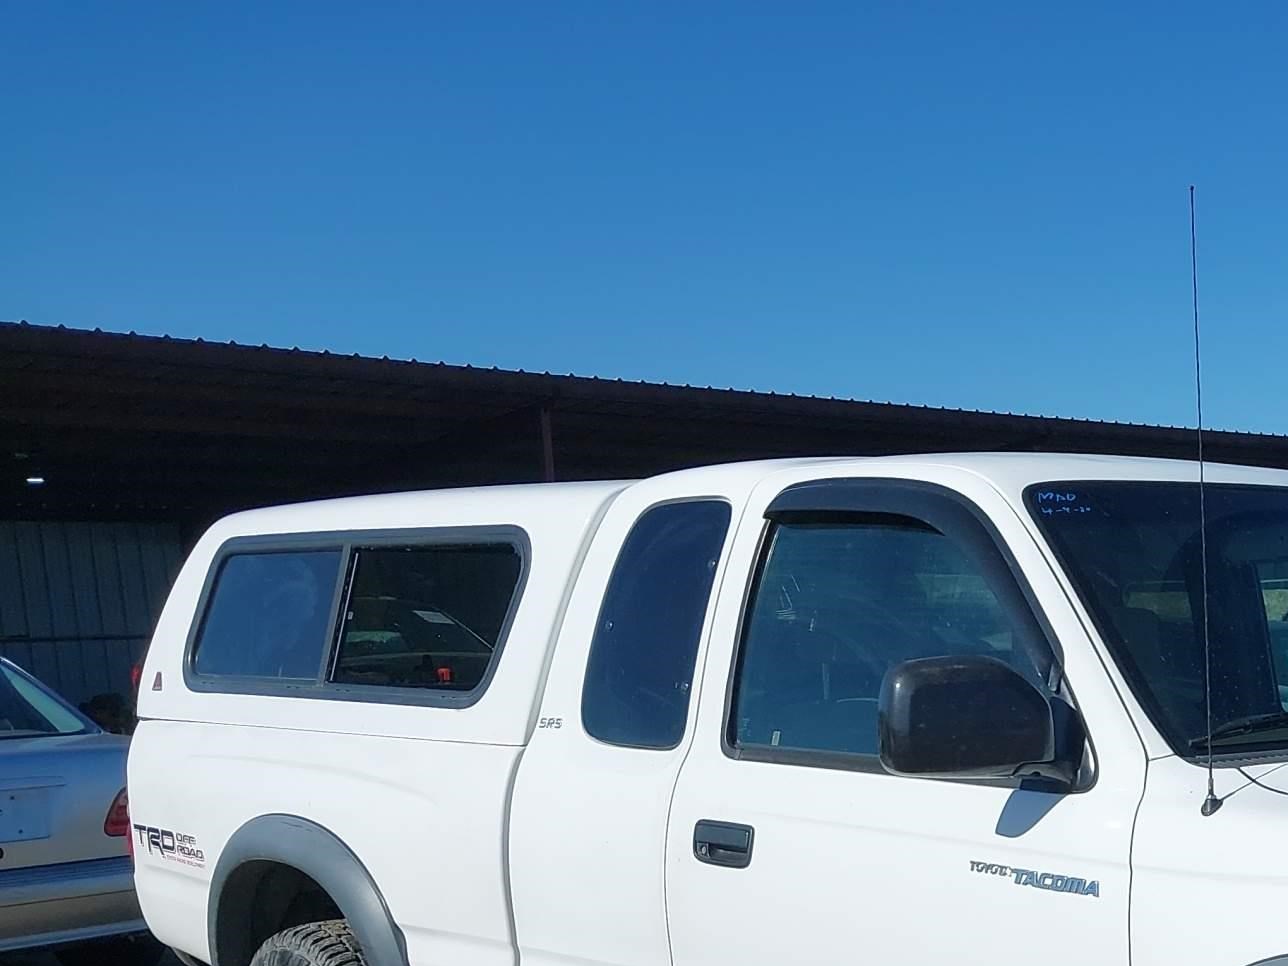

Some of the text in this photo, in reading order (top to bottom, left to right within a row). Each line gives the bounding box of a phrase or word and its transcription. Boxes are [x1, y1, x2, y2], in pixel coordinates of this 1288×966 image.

[539, 717, 563, 729] SR5
[133, 823, 176, 856] TRD
[176, 832, 196, 846] OFF
[176, 844, 205, 861] ROAD
[1012, 868, 1100, 897] TACOMA
